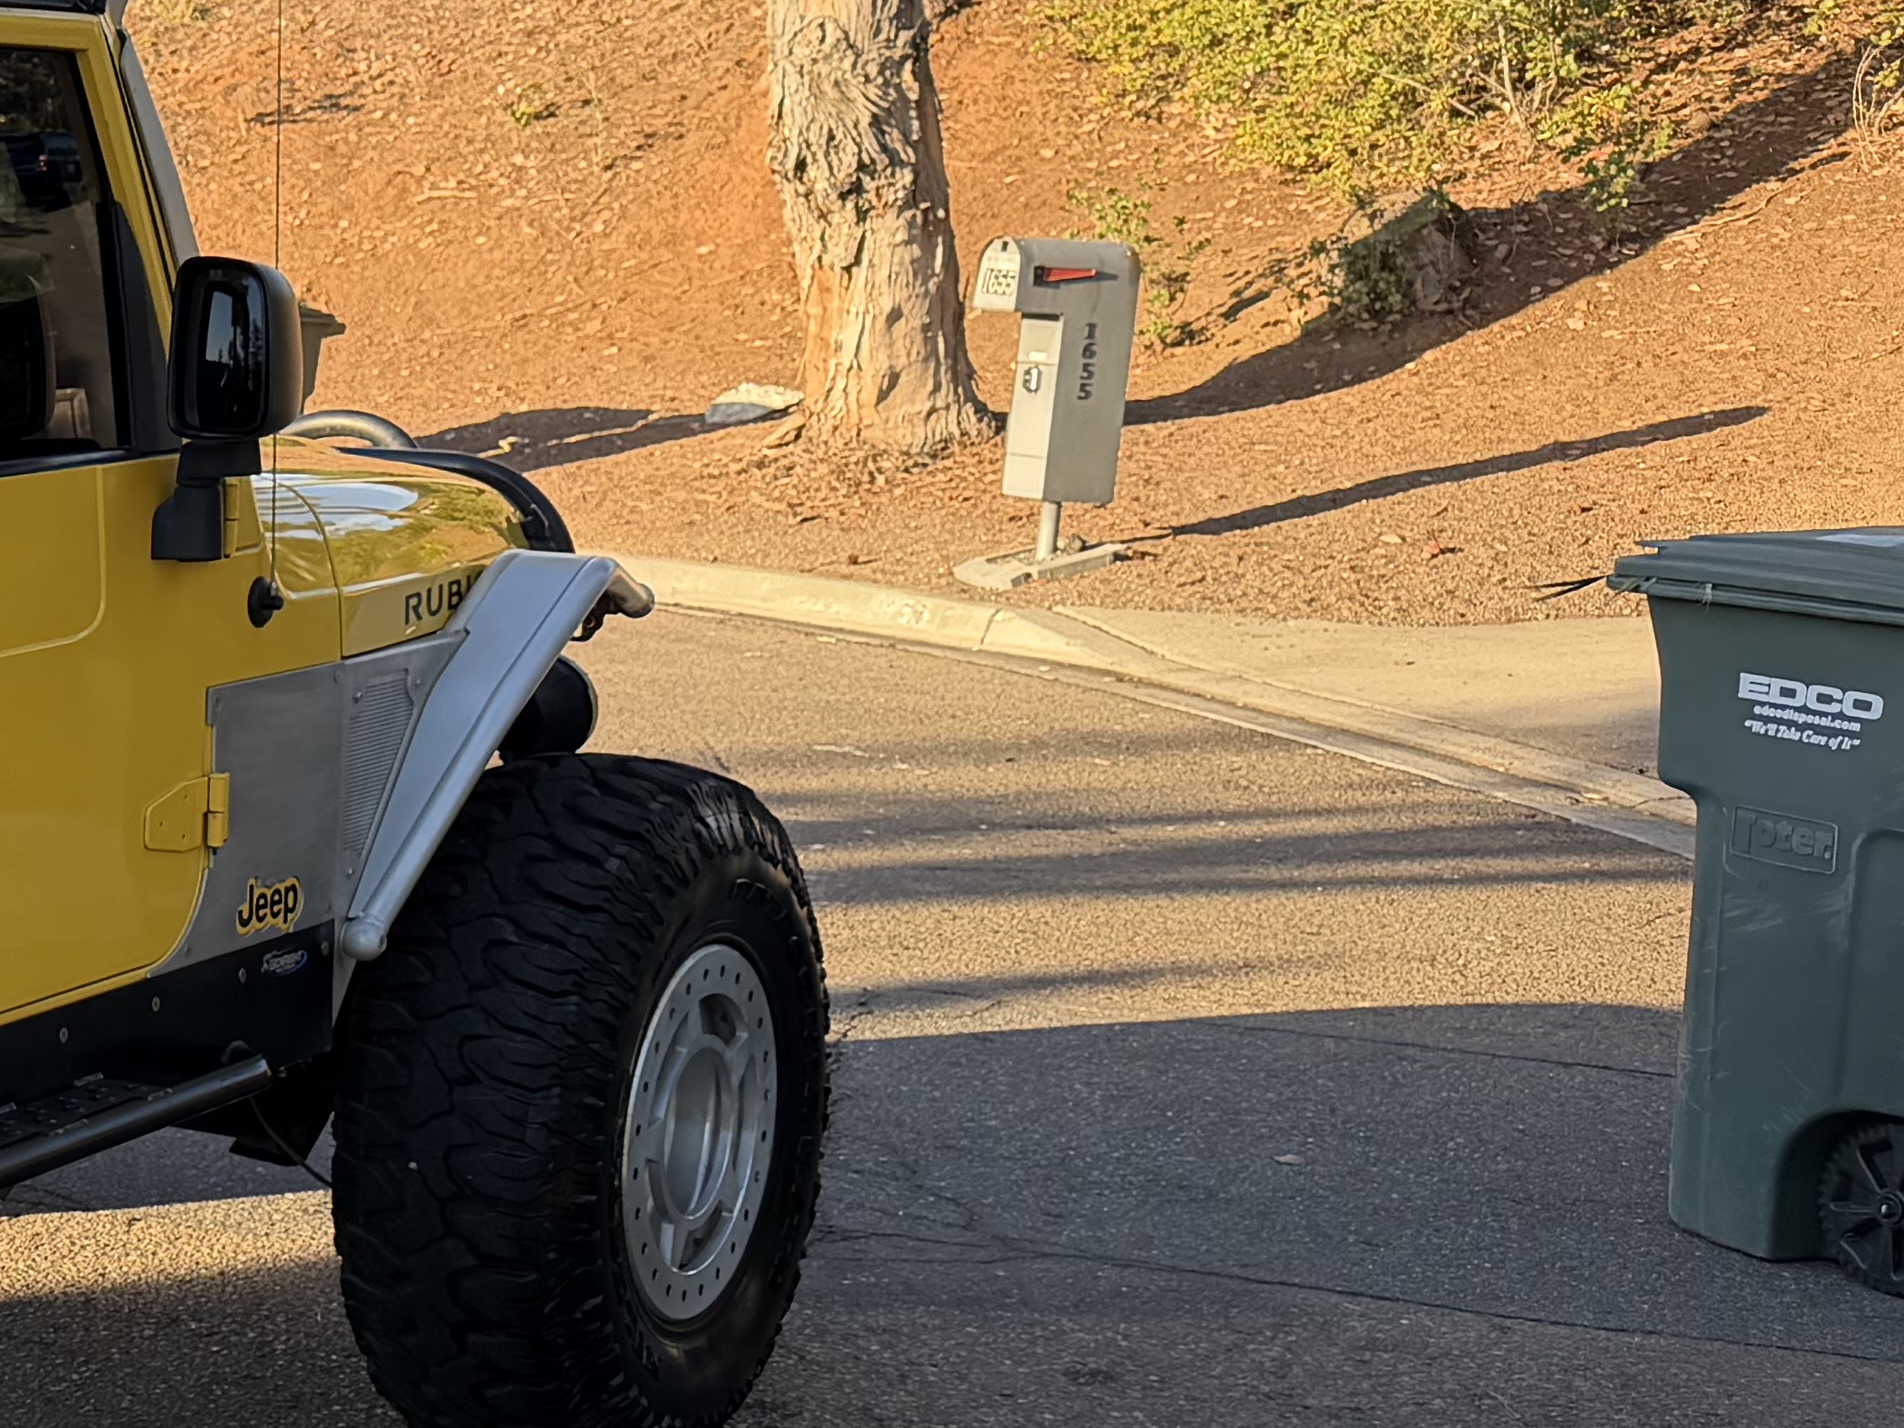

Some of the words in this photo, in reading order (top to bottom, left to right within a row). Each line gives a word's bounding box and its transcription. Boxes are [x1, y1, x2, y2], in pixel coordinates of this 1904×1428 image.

[982, 268, 1016, 296] 1655
[1077, 322, 1098, 402] 1655
[1738, 672, 1884, 720] EDCO
[1753, 704, 1861, 732] edcodisposal.com
[1802, 730, 1828, 746] Care
[1828, 736, 1843, 751] of
[237, 882, 299, 929] Jeep
